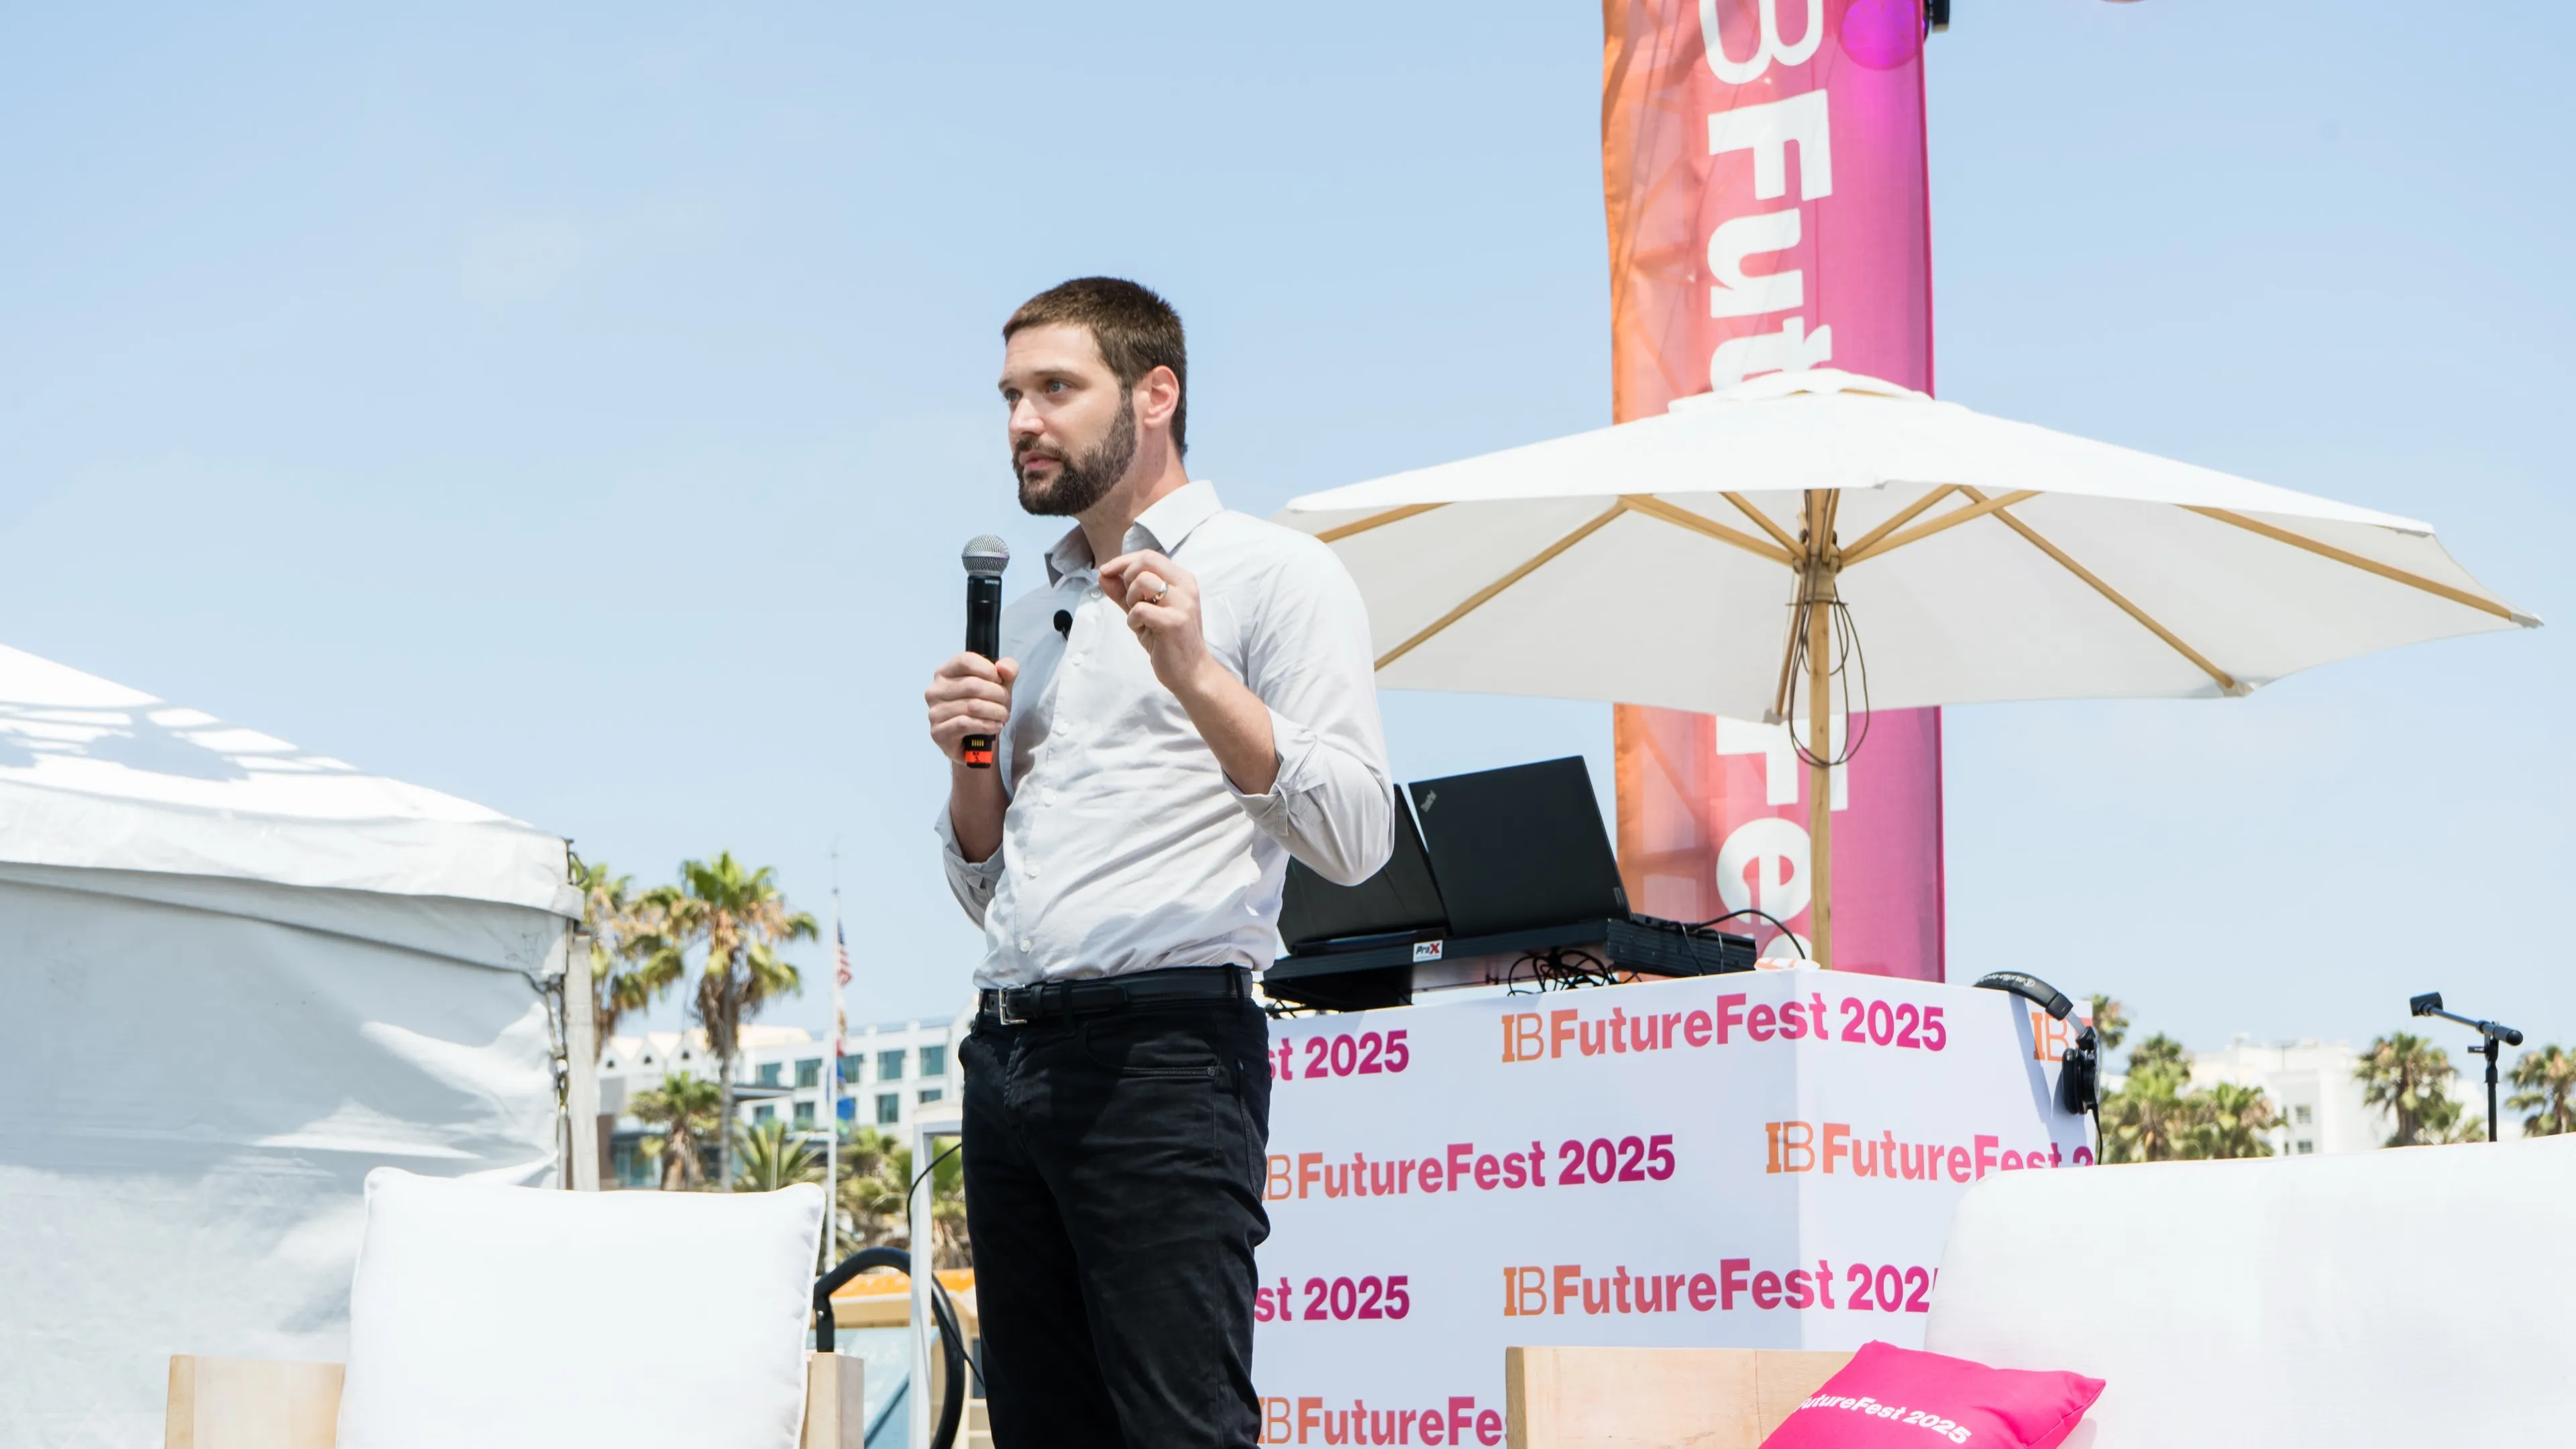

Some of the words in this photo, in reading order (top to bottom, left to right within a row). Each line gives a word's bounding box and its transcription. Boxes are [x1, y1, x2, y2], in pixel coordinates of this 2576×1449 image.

[1840, 997, 1947, 1052] 2025
[2031, 1012, 2093, 1061] IB
[1303, 1030, 1409, 1079] 2025
[1262, 1140, 1546, 1201] BFutureFest
[1558, 1134, 1675, 1185] 2025
[1303, 1275, 1410, 1321] 2025
[1847, 1263, 1939, 1313] 202
[1257, 1396, 1507, 1446] BFutureFe
[1902, 1411, 1972, 1444] 2025
